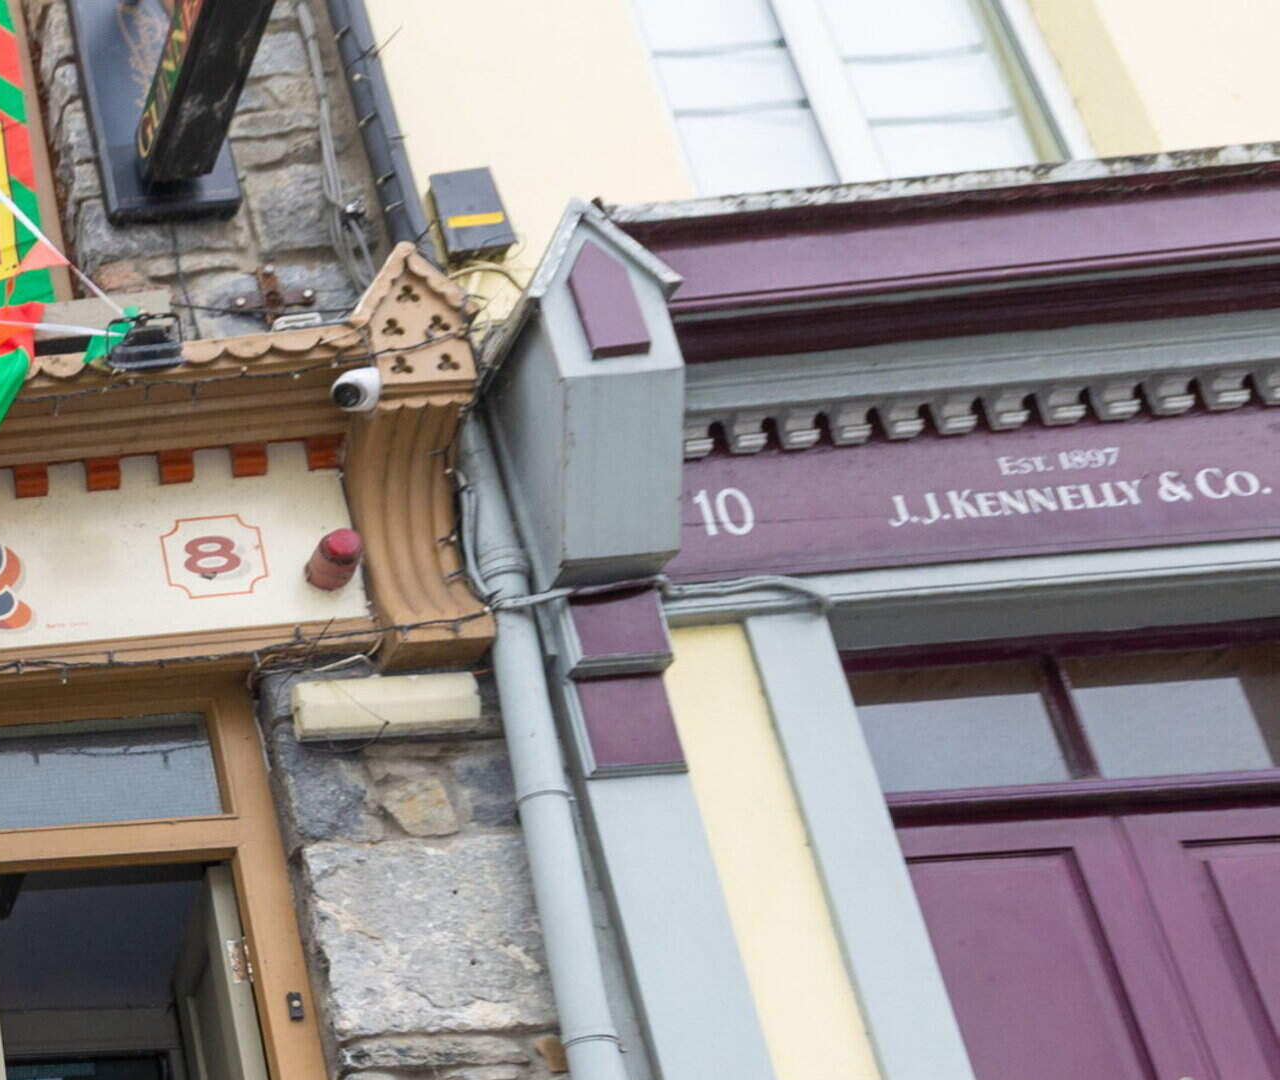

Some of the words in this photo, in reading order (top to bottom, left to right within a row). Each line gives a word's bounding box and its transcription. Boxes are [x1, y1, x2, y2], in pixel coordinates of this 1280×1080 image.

[1058, 447, 1121, 471] 1897
[692, 487, 755, 536] 10
[183, 535, 240, 577] 8
